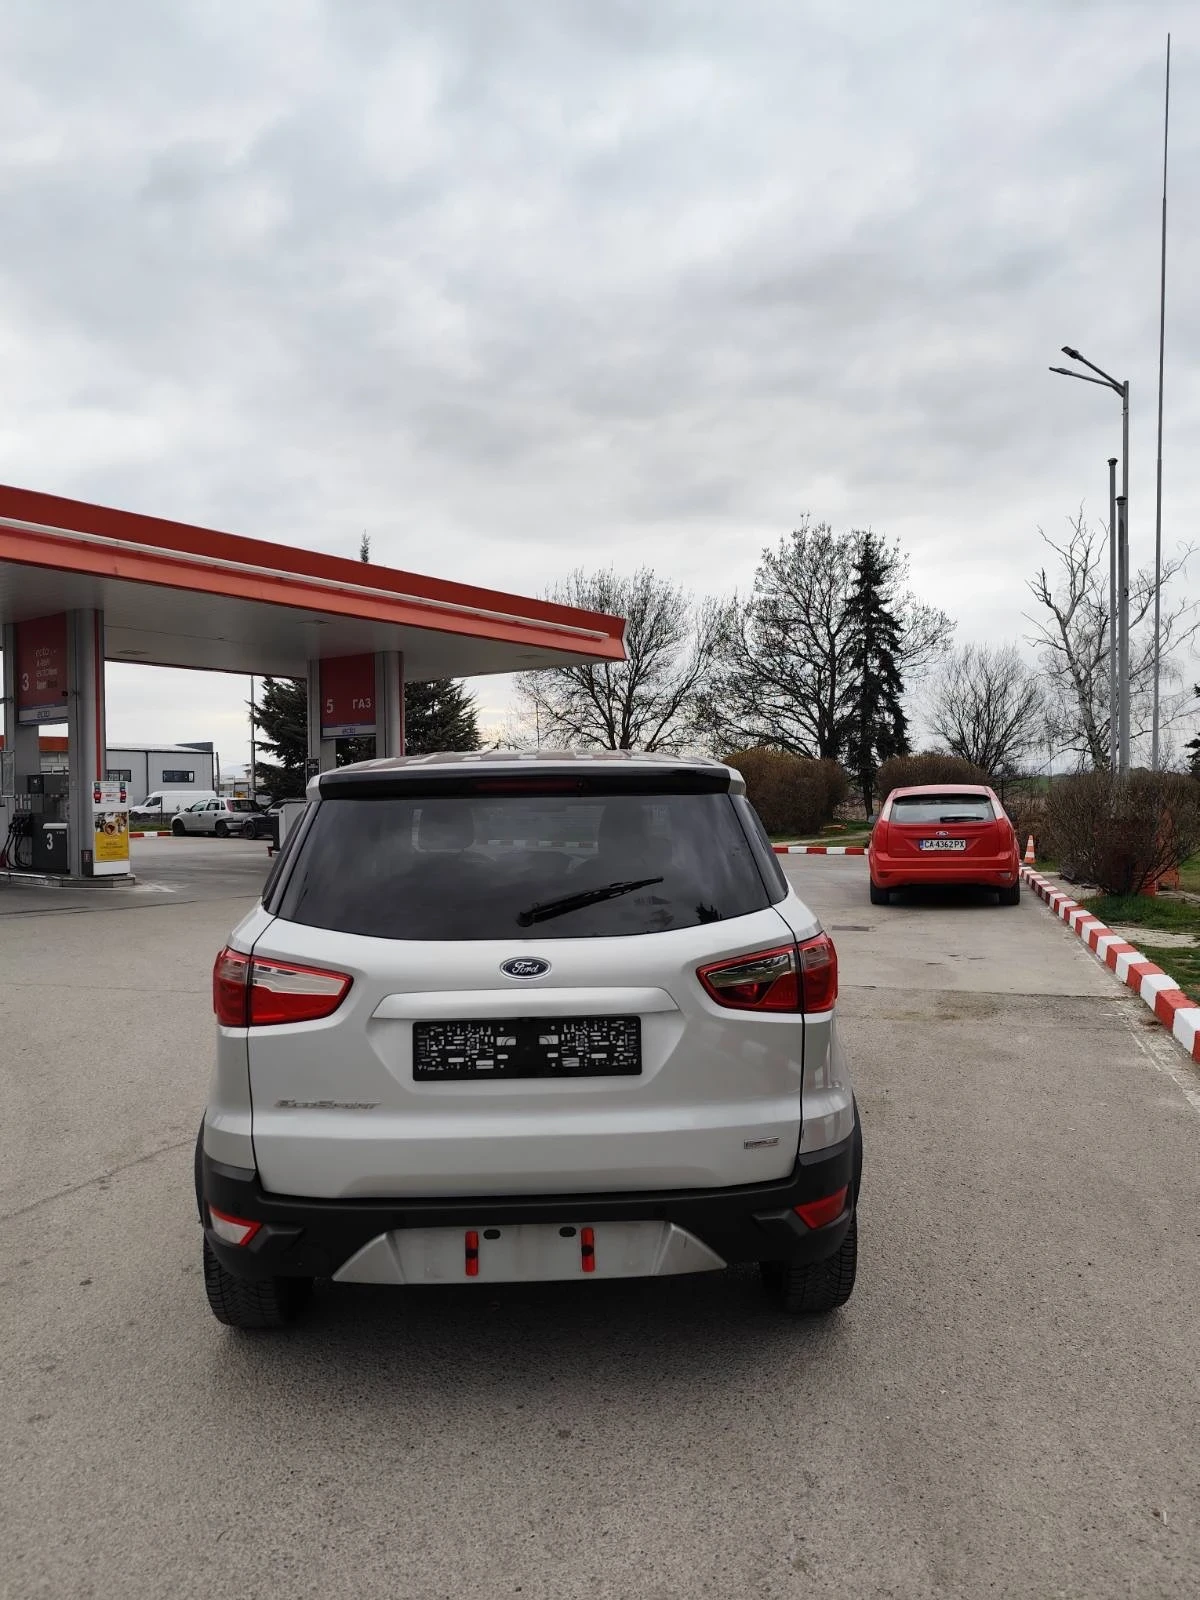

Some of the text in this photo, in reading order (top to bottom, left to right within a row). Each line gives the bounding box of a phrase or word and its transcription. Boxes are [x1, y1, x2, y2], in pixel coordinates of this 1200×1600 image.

[22, 673, 30, 692] 3
[326, 698, 334, 714] 5
[352, 697, 372, 710] ГАЗ
[46, 832, 54, 851] 3
[512, 961, 540, 975] Ford
